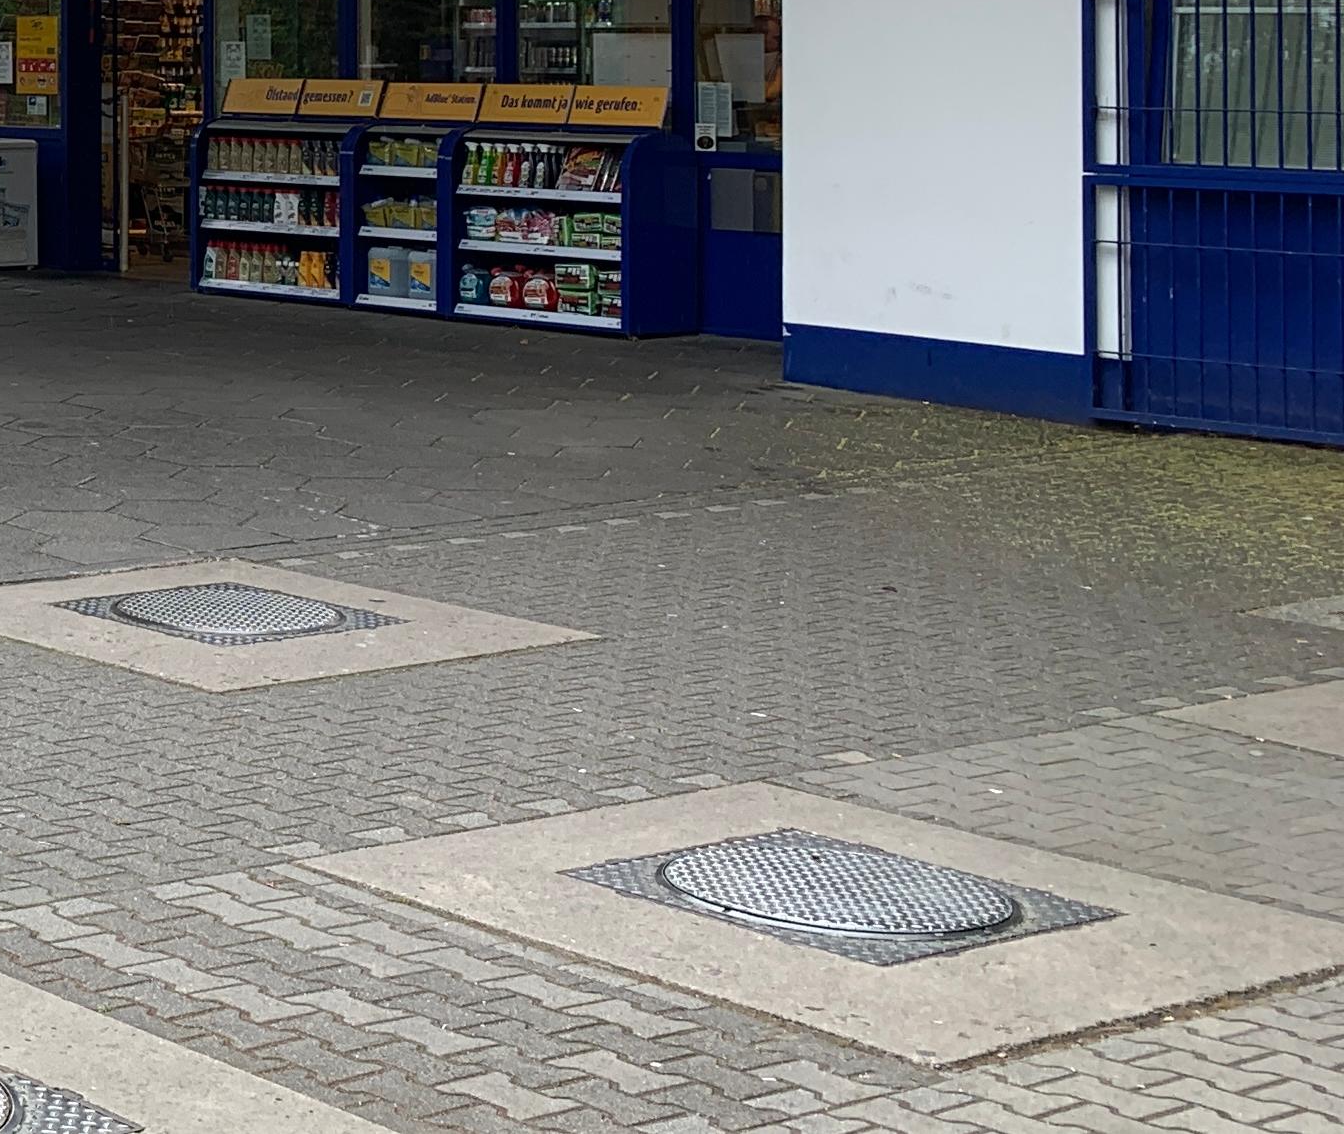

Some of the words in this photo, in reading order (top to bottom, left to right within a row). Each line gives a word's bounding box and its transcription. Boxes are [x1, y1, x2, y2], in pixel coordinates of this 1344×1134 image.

[303, 89, 354, 105] gemessen?
[501, 95, 519, 108] Das
[521, 94, 556, 109] kommt
[556, 96, 569, 113] ja
[575, 95, 594, 109] wie
